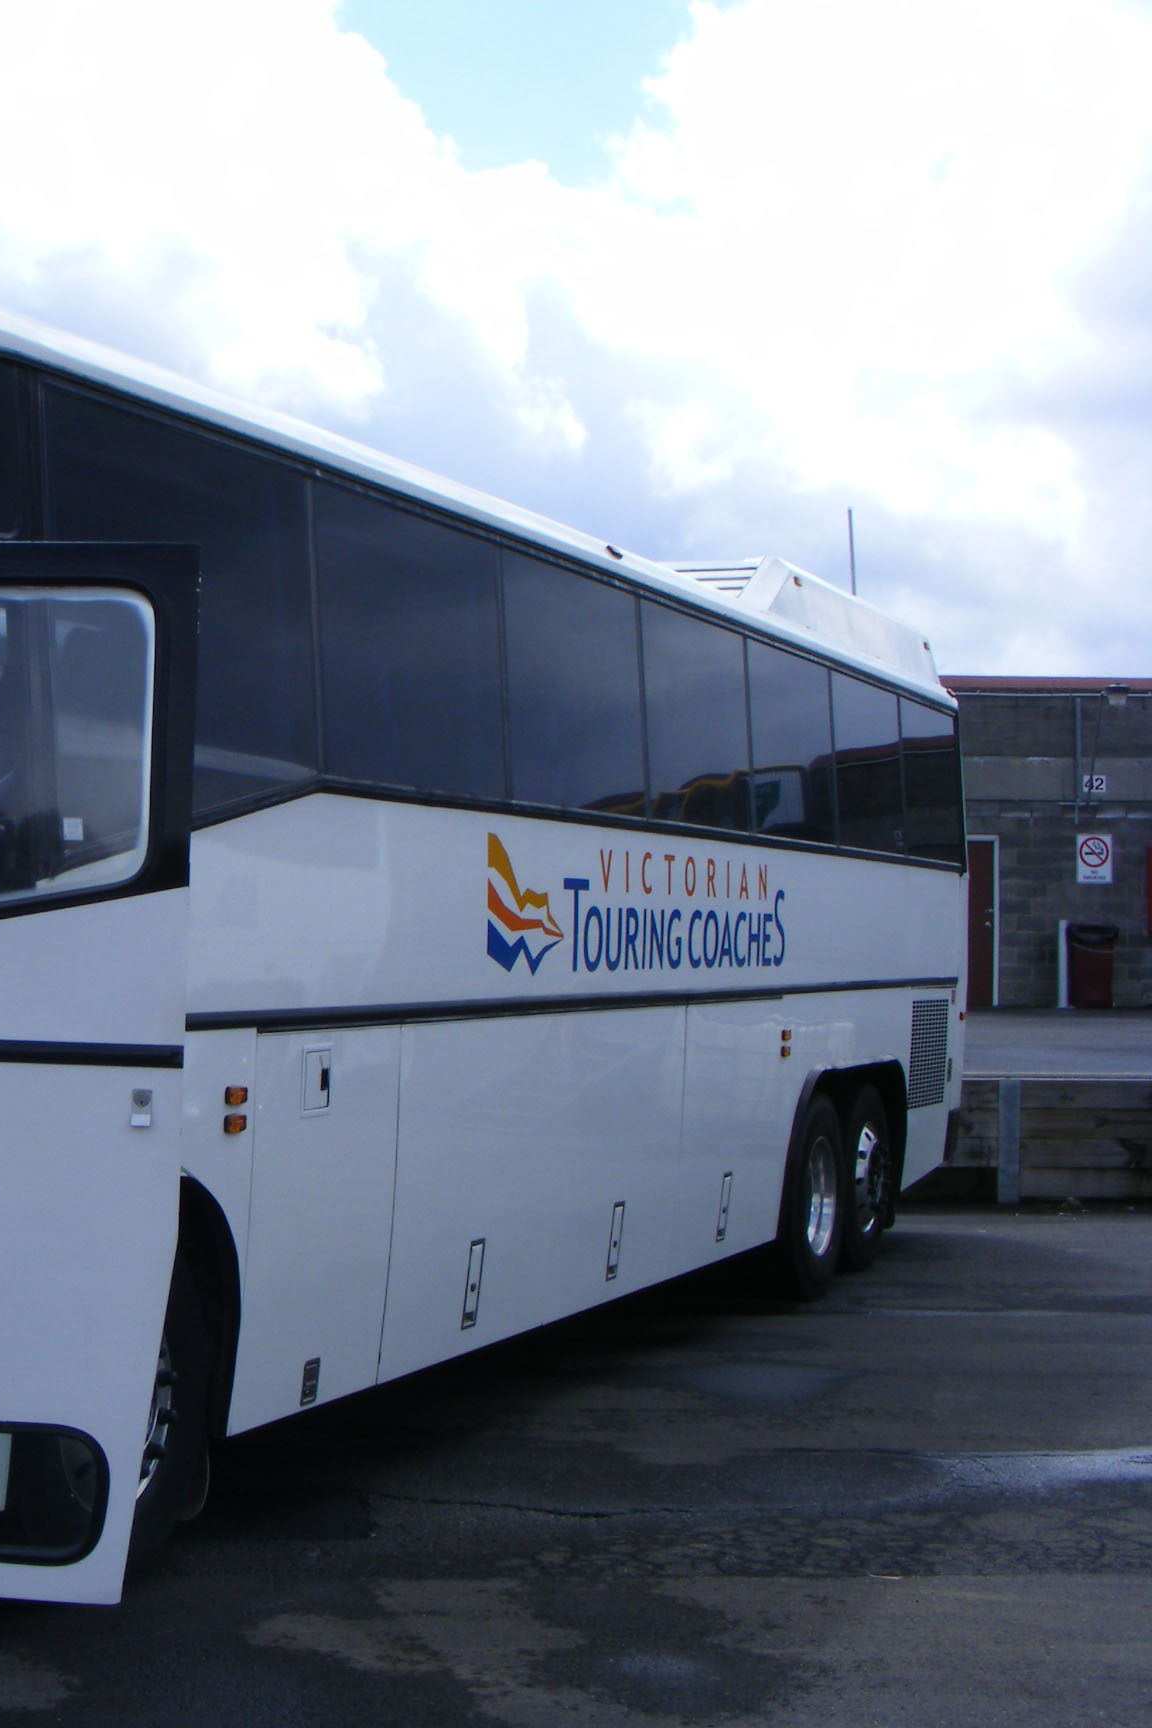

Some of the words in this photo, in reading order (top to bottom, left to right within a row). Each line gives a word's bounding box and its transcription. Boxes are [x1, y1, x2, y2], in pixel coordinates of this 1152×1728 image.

[1084, 776, 1105, 791] 42
[600, 848, 768, 900] VICTORIAN
[563, 877, 682, 972] TOURING
[688, 889, 786, 969] COACHES
